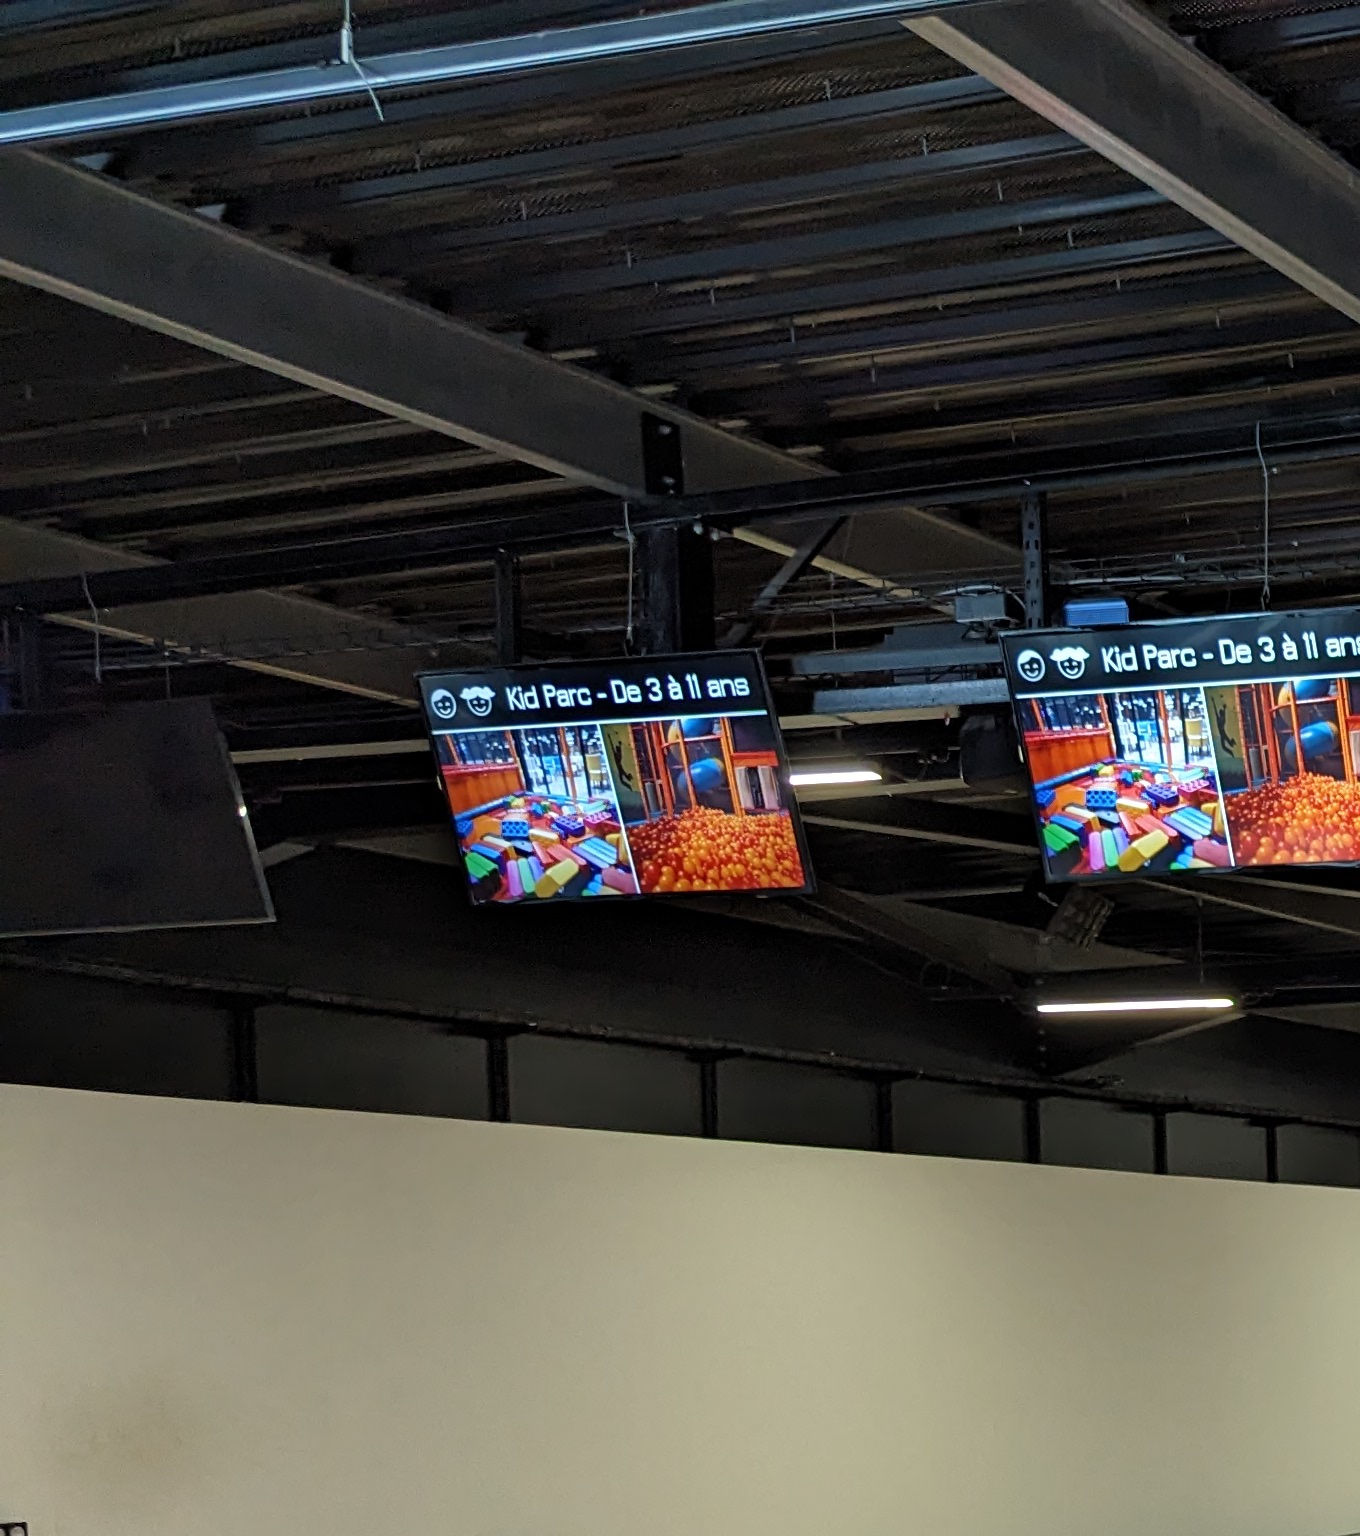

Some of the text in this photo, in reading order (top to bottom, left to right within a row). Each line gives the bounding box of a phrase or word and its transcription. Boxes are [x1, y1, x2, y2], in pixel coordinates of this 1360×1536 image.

[1101, 646, 1139, 674] Kid
[1143, 644, 1197, 671] Parc
[1220, 639, 1252, 666] De
[1258, 636, 1275, 663] 3
[1283, 633, 1299, 661] à
[1303, 631, 1318, 659] 11
[506, 673, 749, 712] Kid Parc De 3 à 11 ans
